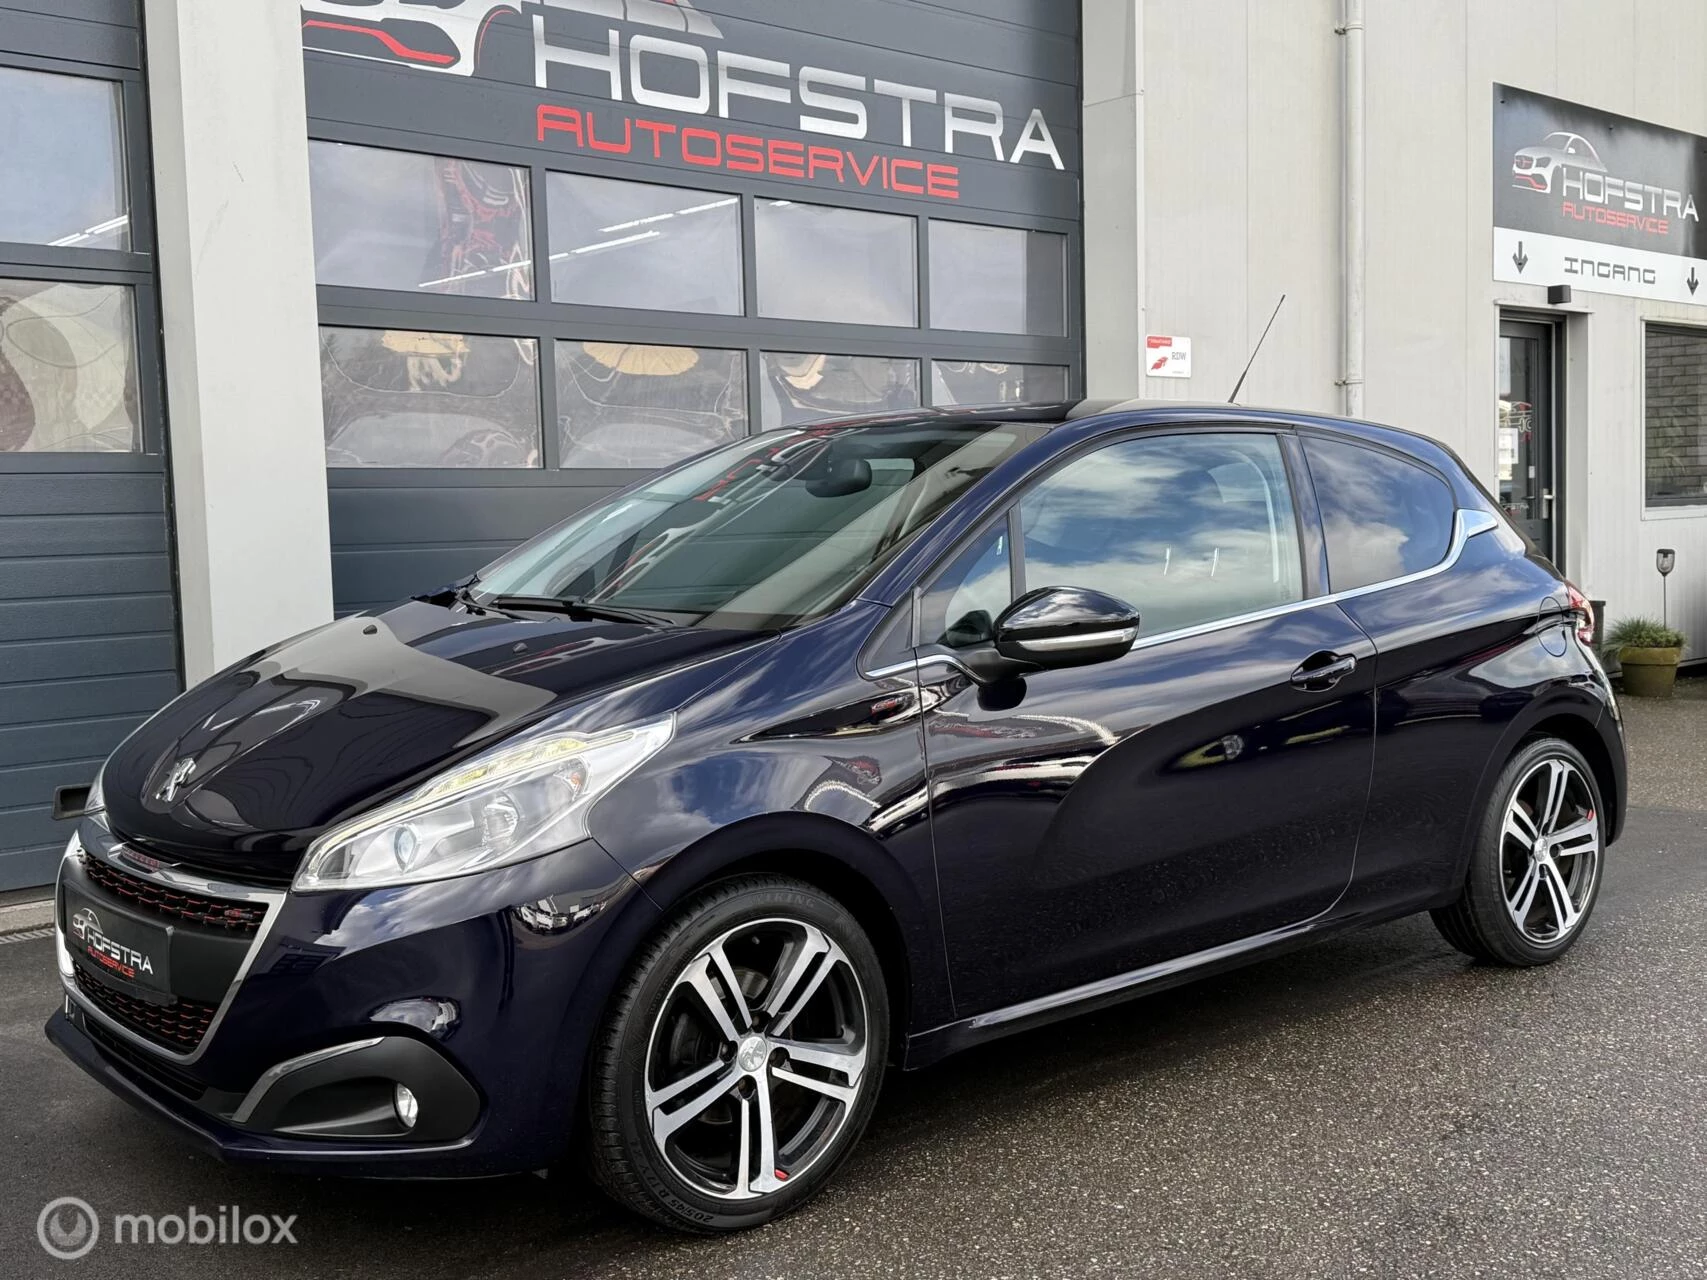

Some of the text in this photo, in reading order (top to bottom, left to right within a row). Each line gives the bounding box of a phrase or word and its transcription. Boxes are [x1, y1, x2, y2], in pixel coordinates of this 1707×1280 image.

[533, 15, 1064, 171] HOFSTRA
[538, 105, 960, 199] AUTOSERVICE
[1561, 201, 1669, 235] AUTOSERVICE
[1562, 167, 1699, 222] HOFSTRA
[1564, 256, 1656, 285] INGANG
[87, 927, 154, 975] HOFSTRA
[87, 945, 135, 978] AUTOSERVICE
